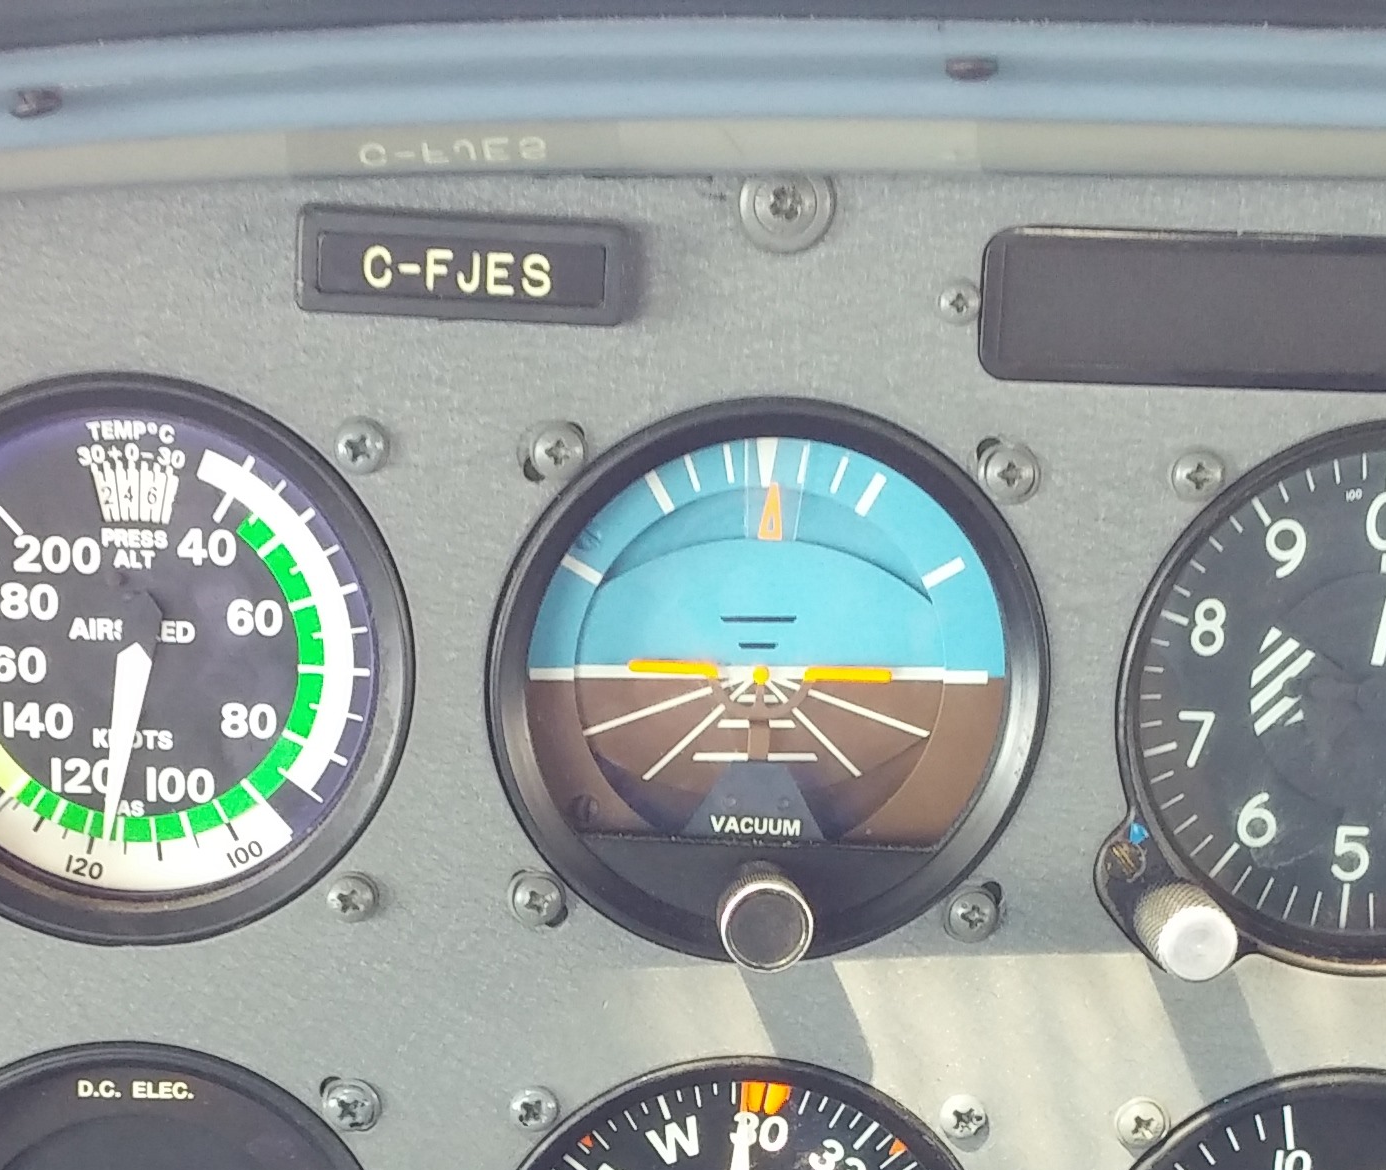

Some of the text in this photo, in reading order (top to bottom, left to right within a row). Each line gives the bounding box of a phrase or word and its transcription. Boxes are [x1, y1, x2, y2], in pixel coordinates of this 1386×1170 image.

[362, 244, 553, 298] C-FJES
[13, 535, 101, 574] 200
[101, 527, 169, 549] PRESS
[177, 529, 237, 566] 40
[113, 549, 156, 569] ALT
[226, 600, 283, 636] 60
[3, 702, 74, 740] 140
[221, 704, 277, 739] 80
[145, 767, 215, 803] 100
[710, 814, 801, 837] VACUUM
[65, 856, 105, 880] 120
[77, 1081, 195, 1101] D.C. ELEC.
